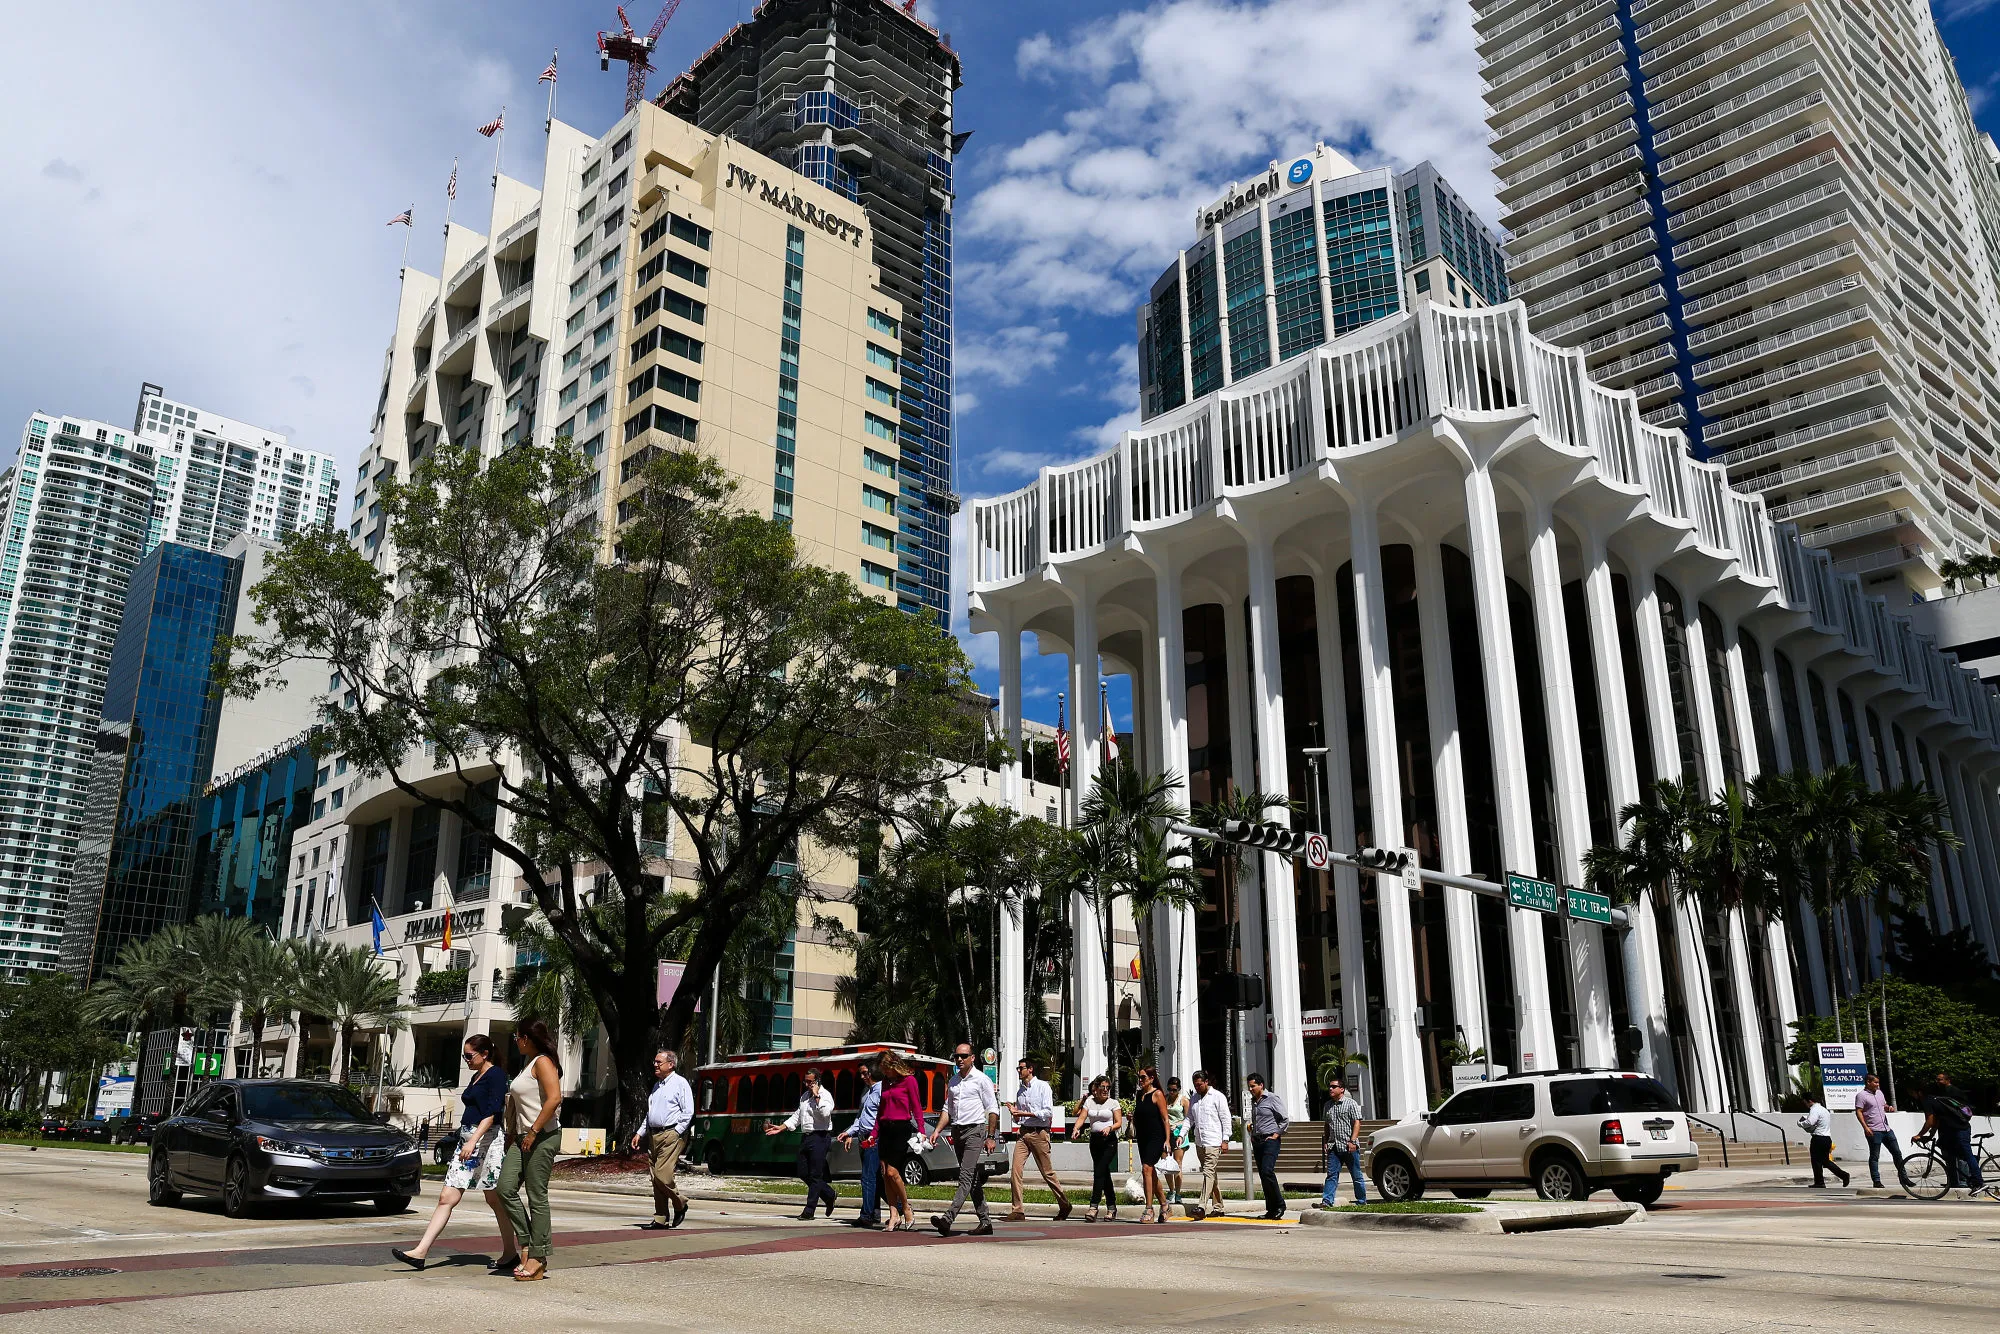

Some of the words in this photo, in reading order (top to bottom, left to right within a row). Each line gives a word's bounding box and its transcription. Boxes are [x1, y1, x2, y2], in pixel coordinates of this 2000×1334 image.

[725, 162, 757, 194] JW
[760, 179, 864, 249] MARRIOTT
[1521, 881, 1532, 894] SE
[1533, 882, 1543, 898] 13
[1545, 887, 1554, 899] ST
[1525, 895, 1540, 906] Coral
[1569, 897, 1578, 910] SE
[1579, 899, 1588, 913] 12
[404, 919, 423, 936] JW
[664, 968, 684, 977] BRICK
[1301, 1015, 1338, 1024] harmacy
